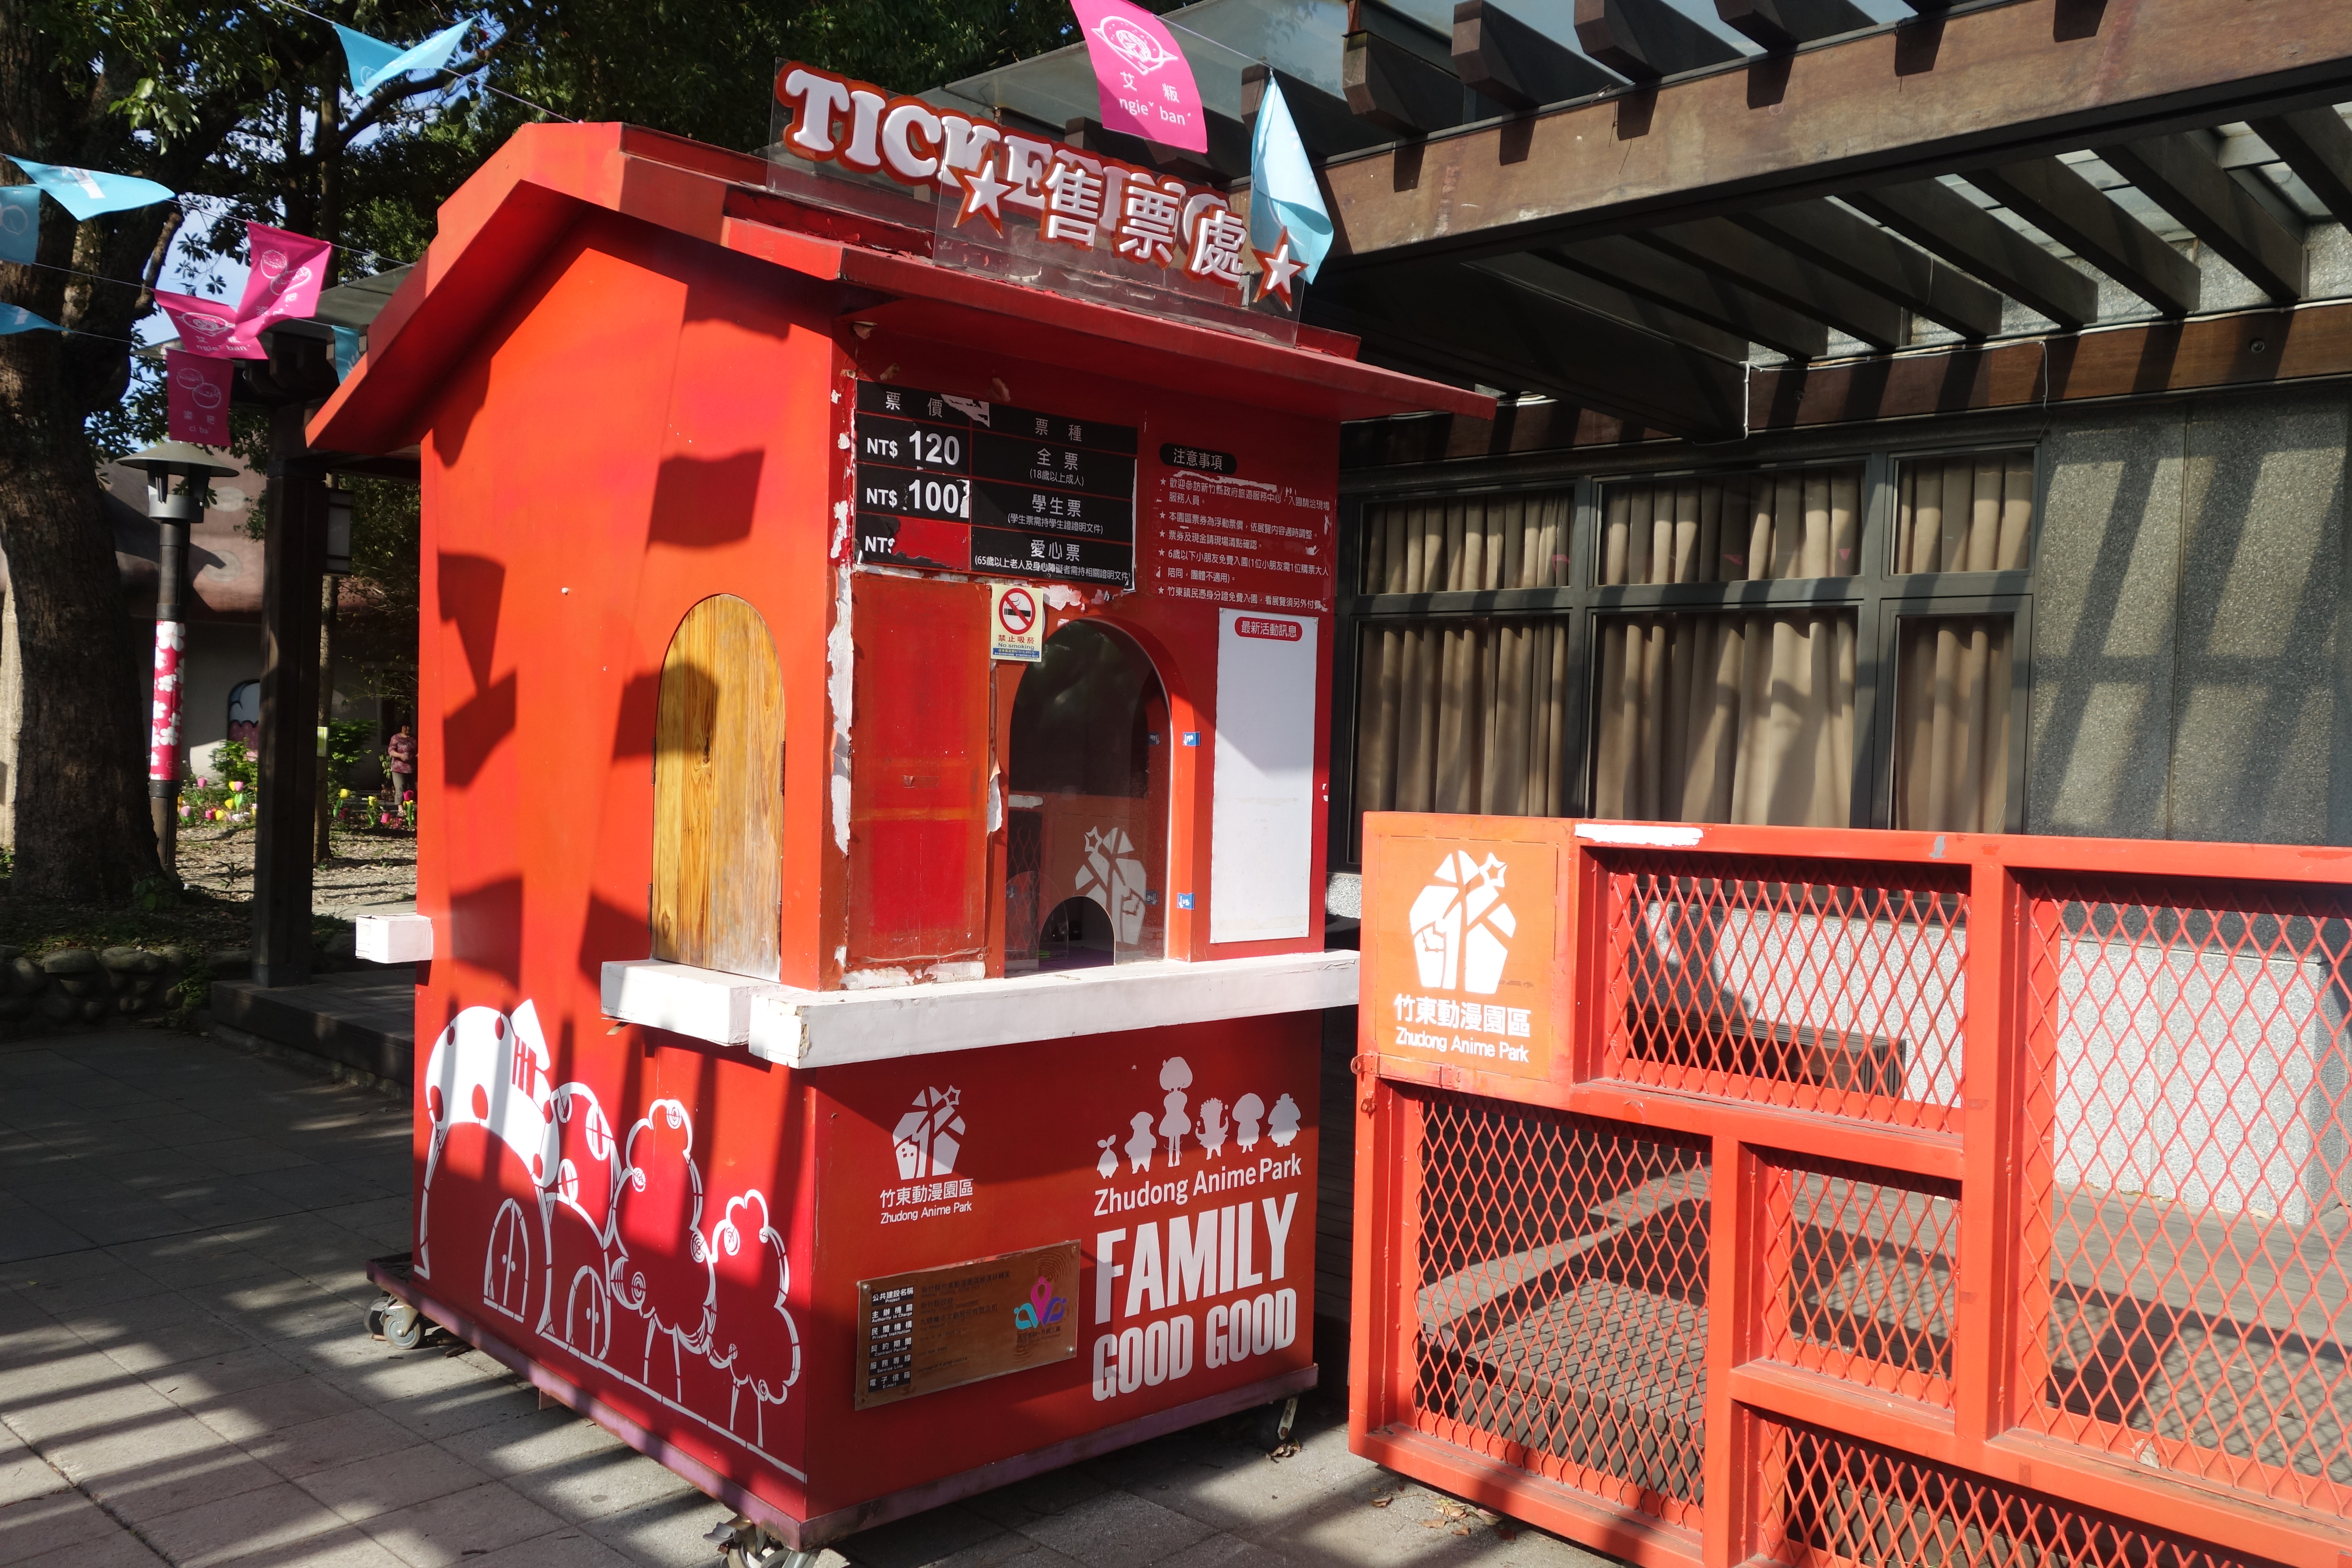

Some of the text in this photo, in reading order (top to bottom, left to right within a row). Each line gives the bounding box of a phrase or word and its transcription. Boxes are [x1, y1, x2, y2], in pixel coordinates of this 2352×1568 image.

[1046, 162, 1247, 282] 售票處
[886, 391, 943, 418] 票價
[1035, 417, 1082, 442] 票種
[867, 430, 960, 466] NT$ 120
[1037, 448, 1078, 471] 全票
[1173, 448, 1223, 471] 注意事項
[1030, 468, 1084, 487] (18歲以上成人)
[867, 479, 959, 514] NT$ 100
[1032, 494, 1081, 518] 學生票
[1169, 491, 1205, 506] 服務人員。
[1008, 513, 1103, 535] (學生票需持學生證證明文件)
[1031, 539, 1080, 562] 愛心票
[1168, 530, 1262, 550] 票券及現金請現場清點確認。
[1168, 567, 1235, 584] 陪同，團體不適用)。
[998, 634, 1035, 644] 禁止吸菸
[1241, 620, 1297, 638] 最新活動訊息
[1394, 993, 1531, 1037] 竹東動漫園區
[1396, 1026, 1529, 1063] Zhudong Anime Park
[880, 1178, 974, 1209] 竹東動漫園區
[1094, 1153, 1302, 1216] Zhudong Anime Park
[881, 1200, 972, 1224] Zhudong Anime Park
[1095, 1192, 1298, 1325] FAMILY
[873, 1287, 913, 1302] 公共建設名稱
[872, 1304, 913, 1319] 主辦機關
[871, 1320, 912, 1336] 民間機構
[870, 1337, 912, 1353] 契約期間
[1092, 1288, 1296, 1402] GOOD GOOD
[870, 1354, 911, 1370] 服務專線
[870, 1371, 910, 1387] 電子信箱
